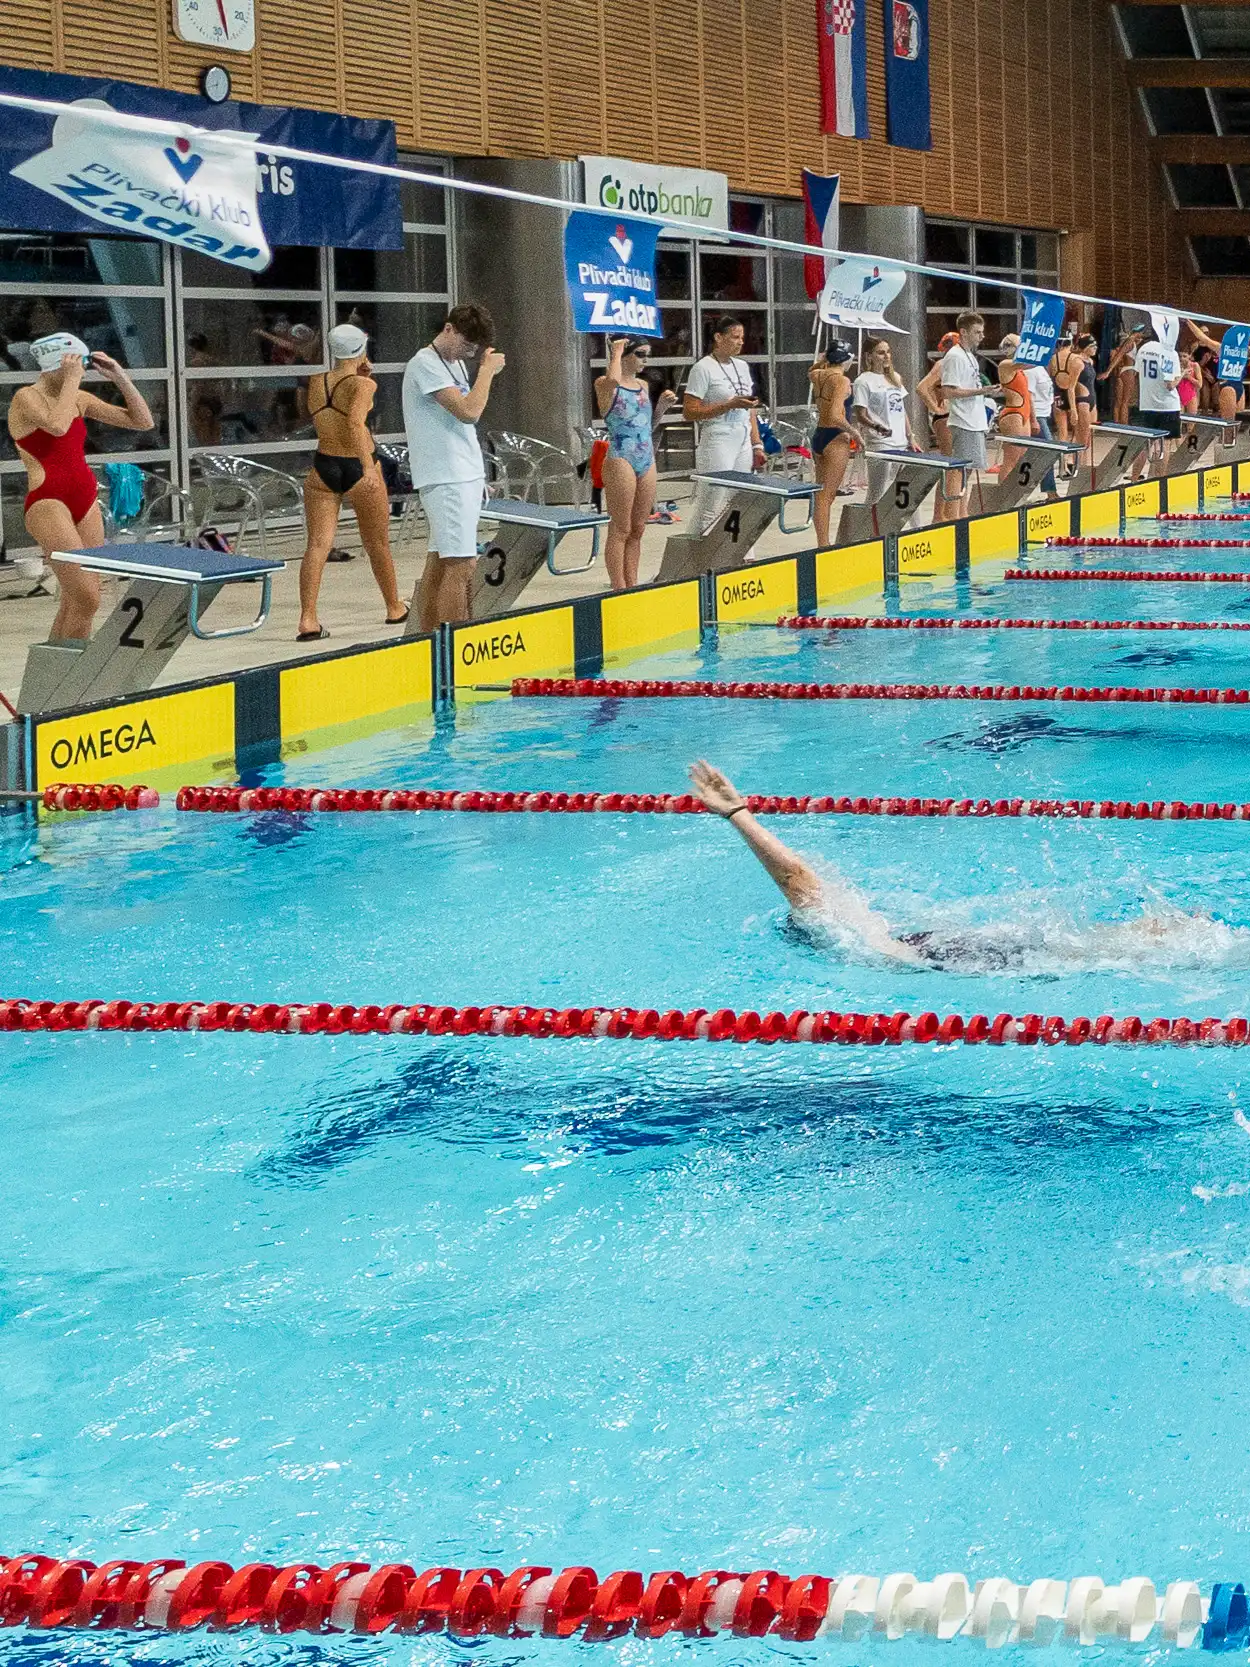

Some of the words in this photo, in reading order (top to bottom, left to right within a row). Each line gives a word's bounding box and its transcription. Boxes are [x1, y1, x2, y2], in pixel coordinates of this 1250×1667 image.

[234, 10, 245, 21] 20
[212, 26, 223, 37] 30
[82, 162, 200, 218] Plivački
[208, 193, 252, 228] klub
[50, 173, 261, 261] Zadar
[577, 262, 632, 288] Plivački
[582, 291, 657, 330] Zadar
[1034, 320, 1056, 338] klub
[1142, 358, 1158, 379] 15
[1117, 444, 1128, 466] 7
[894, 481, 910, 509] 5
[723, 510, 741, 543] 4
[901, 541, 933, 563] OMEGA
[484, 547, 507, 587] 3
[721, 578, 766, 606] OMEGA
[119, 597, 145, 649] 2
[461, 630, 527, 666] OMEGA
[50, 718, 157, 770] OMEGA
